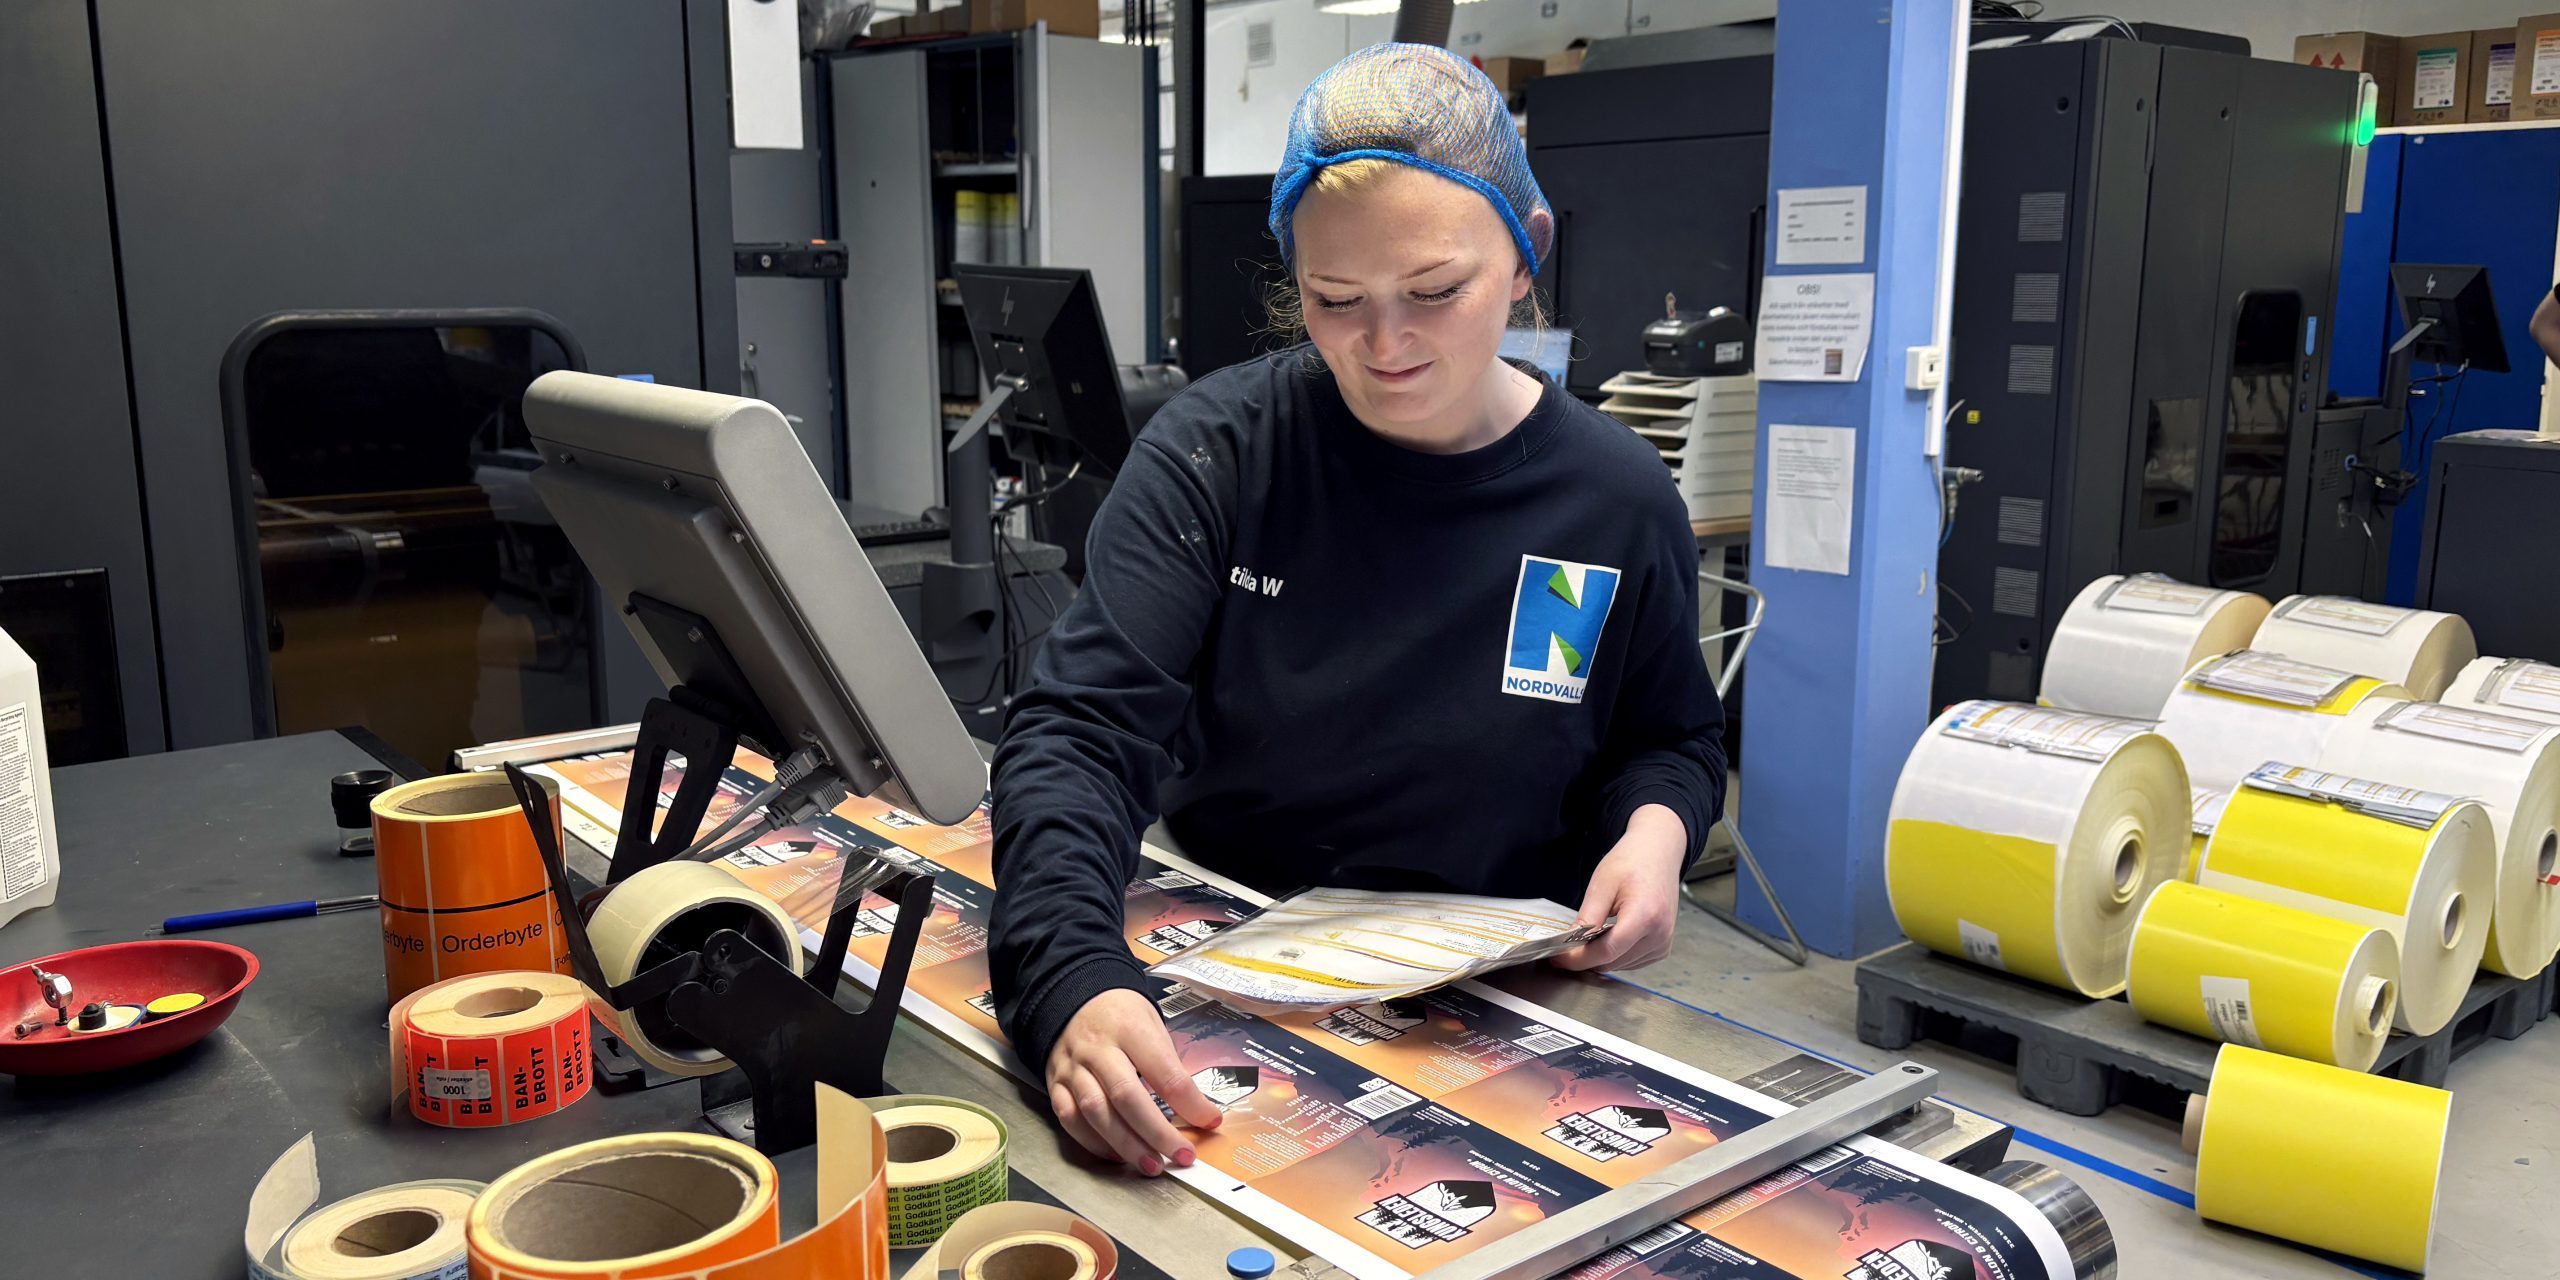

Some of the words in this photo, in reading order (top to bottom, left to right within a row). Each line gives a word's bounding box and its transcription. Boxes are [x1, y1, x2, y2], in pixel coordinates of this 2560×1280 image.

[1262, 575, 1284, 597] W
[442, 923, 543, 953] Orderbyte
[573, 1029, 584, 1086] BROTT
[531, 1047, 547, 1105] BROTT
[563, 1051, 574, 1093] BAN-
[443, 1085, 465, 1095] 1000
[513, 1067, 528, 1109] BAN-
[1561, 1113, 1648, 1155] KUNGSLEDEN
[904, 1189, 940, 1202] Godkänt
[944, 1176, 976, 1194] Godkänt
[904, 1199, 941, 1211] Godkänt
[945, 1185, 976, 1203] Godkänt
[905, 1208, 941, 1219] Godkänt
[946, 1195, 977, 1211] Godkänt
[1379, 1195, 1468, 1241] KUNGSLEDEN
[906, 1217, 942, 1229] Godkänt
[907, 1226, 943, 1238] Godkänt
[1941, 1221, 1978, 1245] CITRON
